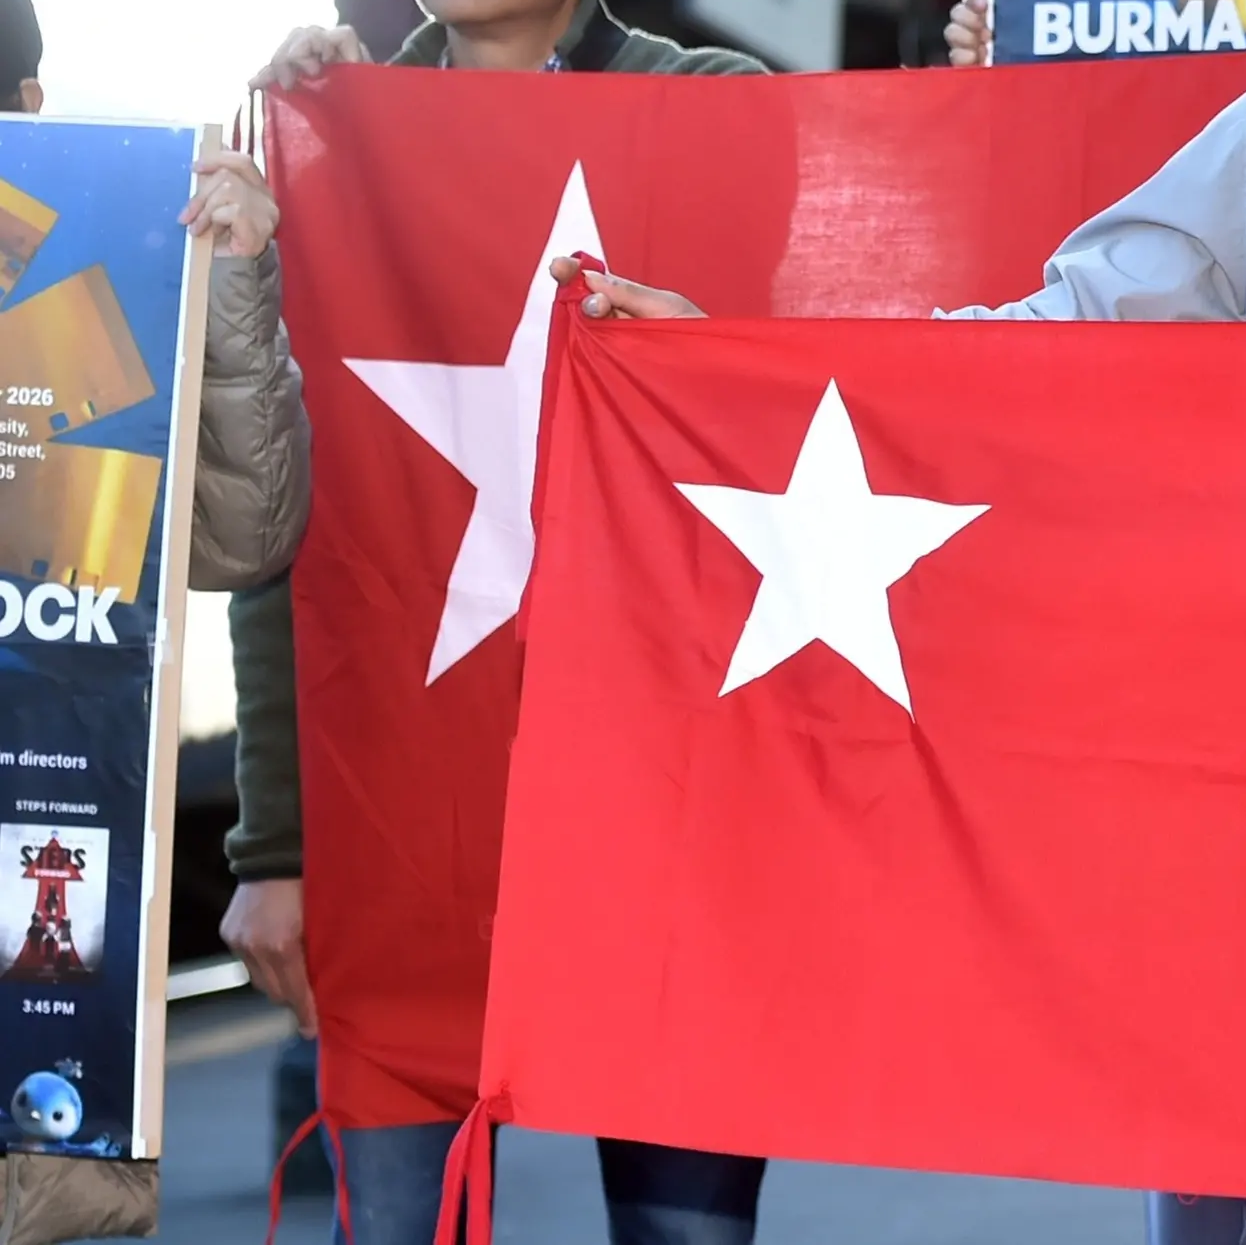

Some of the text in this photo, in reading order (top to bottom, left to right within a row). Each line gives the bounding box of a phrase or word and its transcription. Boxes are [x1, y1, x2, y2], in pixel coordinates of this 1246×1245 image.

[6, 386, 54, 406] 2026
[0, 440, 46, 461] Street,
[18, 749, 87, 770] directors
[15, 800, 98, 815] STEPS FORWARD
[22, 999, 76, 1016] 3:45 PM
